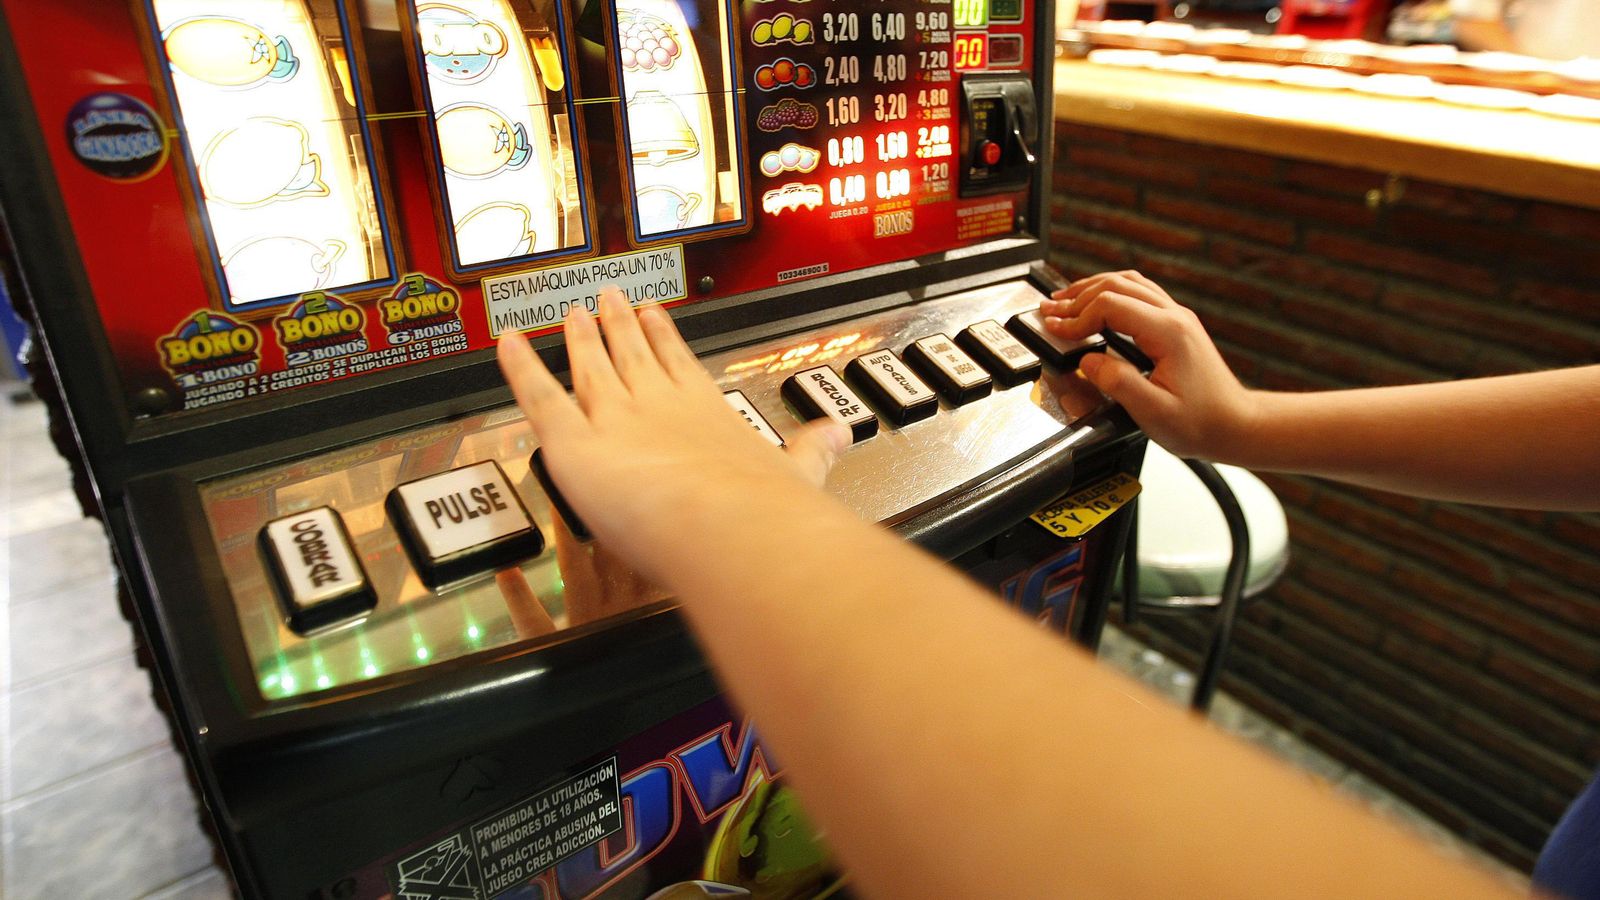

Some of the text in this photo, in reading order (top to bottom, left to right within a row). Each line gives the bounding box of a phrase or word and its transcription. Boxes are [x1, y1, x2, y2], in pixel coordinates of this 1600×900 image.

[823, 12, 948, 44] 3,20 6,40 9,60
[825, 51, 948, 87] 2,40 4,80 7,20
[826, 89, 948, 127] 1,60 3,20 4,80
[828, 136, 864, 168] 0,80
[876, 131, 908, 162] 1,60
[921, 163, 948, 181] 1,20
[875, 210, 913, 237] BONOS
[404, 274, 426, 295] 3
[490, 251, 676, 301] ESTA MÁQUINA PAGA UN 70%
[302, 292, 328, 314] 2
[384, 290, 455, 323] BONO
[495, 302, 556, 332] MÍNIMO
[194, 311, 212, 334] 1
[280, 309, 359, 343] BONO
[388, 332, 411, 345] 6
[414, 321, 462, 340] BONOS
[165, 328, 254, 366] BONO
[287, 352, 312, 366] 2
[312, 339, 368, 361] BONOS
[870, 353, 892, 366] AUTO
[184, 342, 468, 410] JUGANDO A 3 CREDITOS SE TRIPLICAN LOS BONOS
[186, 380, 245, 400] JUGANDO
[249, 377, 258, 386] A
[261, 375, 269, 384] 2
[272, 363, 331, 381] CREDITOS
[333, 358, 347, 368] SE
[351, 346, 406, 365] DUPLICAN
[409, 341, 428, 353] LOS
[432, 334, 466, 348] BONOS
[201, 361, 257, 382] BONO
[810, 372, 850, 407] BANCO
[425, 482, 508, 530] PULSE
[1049, 521, 1068, 533] 5
[1065, 512, 1082, 524] Y
[1085, 500, 1111, 515] 10
[290, 519, 343, 588] COBRAR
[476, 765, 613, 844] PROHIBIDA LA UTILIZACIÓN
[480, 788, 603, 860] A MENORES DE 18 AÑOS.
[483, 801, 618, 880] LA PRÁCTICA ABUSIVA DEL
[487, 824, 605, 894] JUEGO CREA ADICCIÓN.
